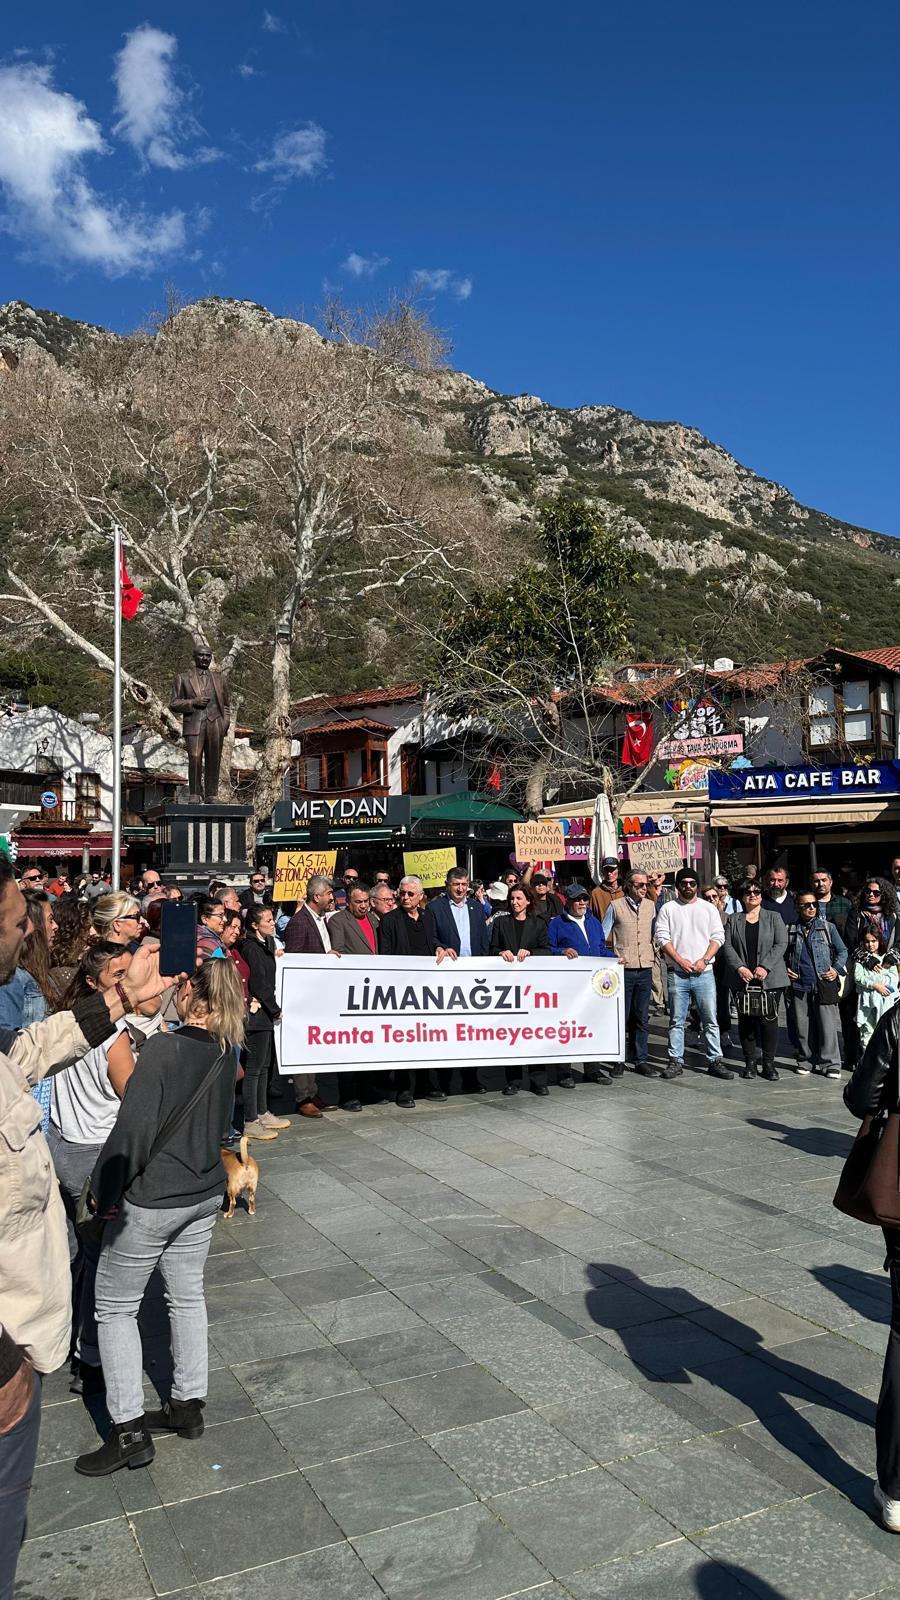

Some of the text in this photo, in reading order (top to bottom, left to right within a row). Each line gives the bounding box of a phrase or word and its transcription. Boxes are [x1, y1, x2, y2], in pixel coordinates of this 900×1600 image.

[744, 769, 881, 790] ATA CAFE BAR
[292, 797, 387, 819] MEYDAN
[517, 825, 562, 835] KIYILARA
[518, 835, 562, 845] KIYMAYIN
[641, 850, 679, 860] YOK ETMEK
[420, 862, 448, 871] SAYGI
[307, 1020, 594, 1045] Ranta Teslim Etmeyeceğiz.
